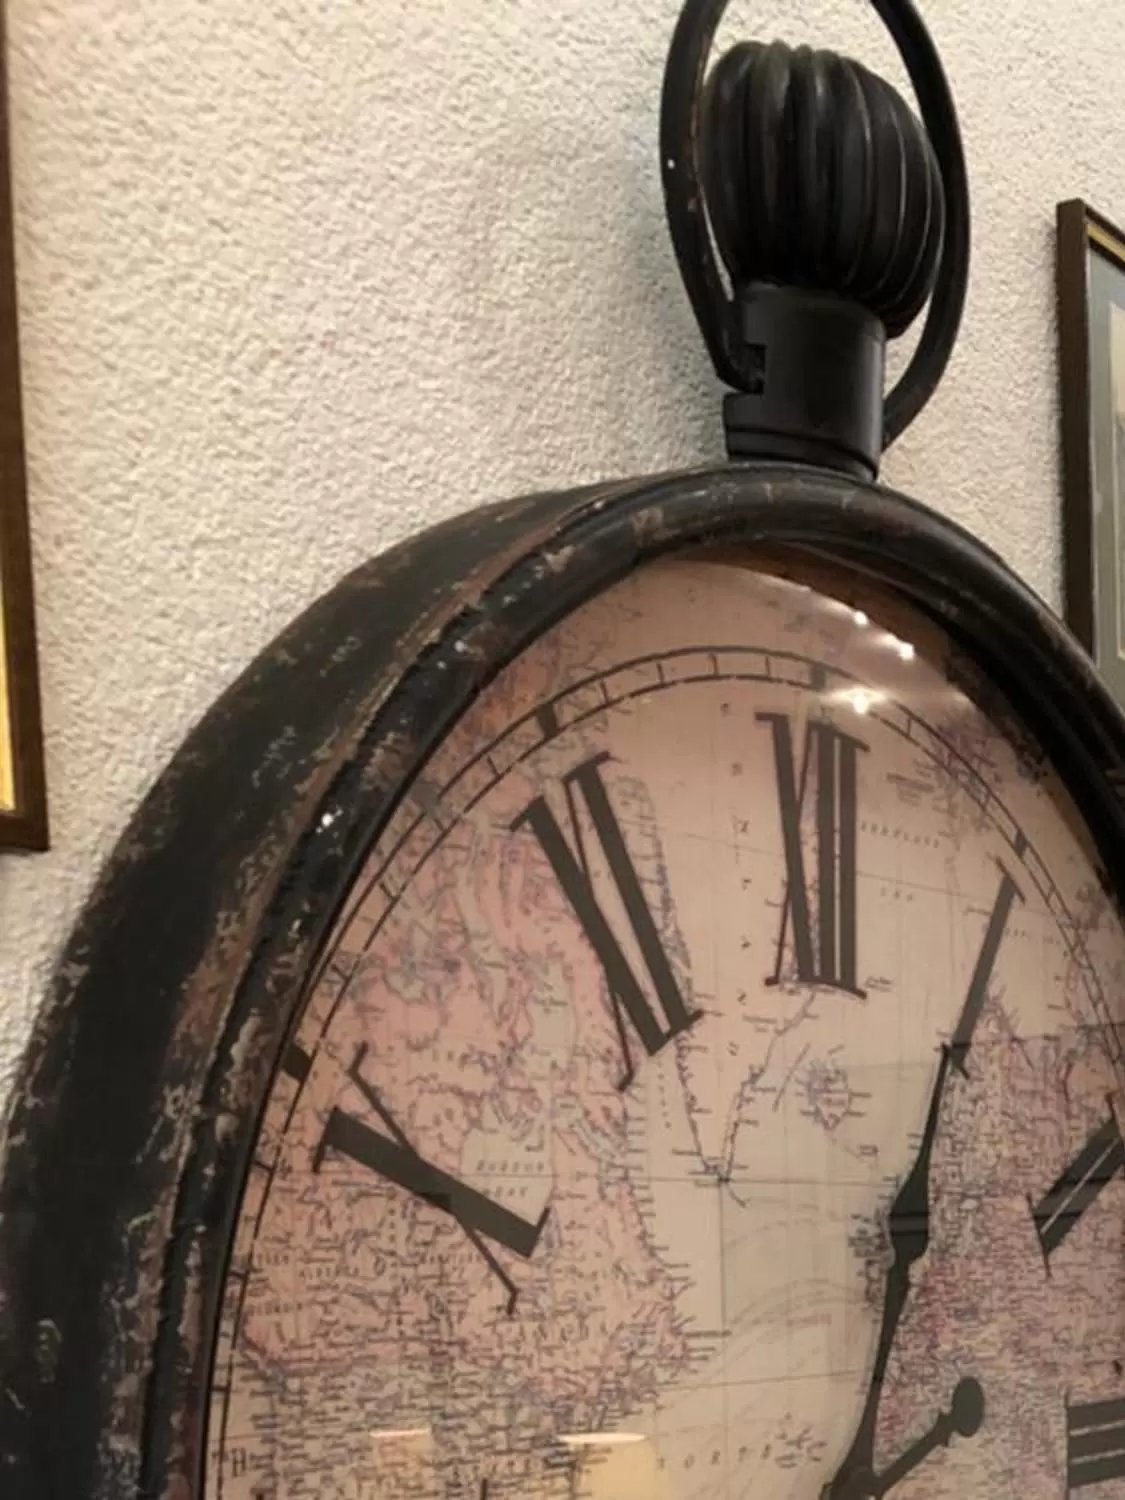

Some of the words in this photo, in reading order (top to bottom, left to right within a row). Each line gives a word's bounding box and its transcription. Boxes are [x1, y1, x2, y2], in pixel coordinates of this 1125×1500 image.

[510, 751, 704, 1092] XI
[755, 712, 870, 999] XII
[311, 1040, 550, 1315] X
